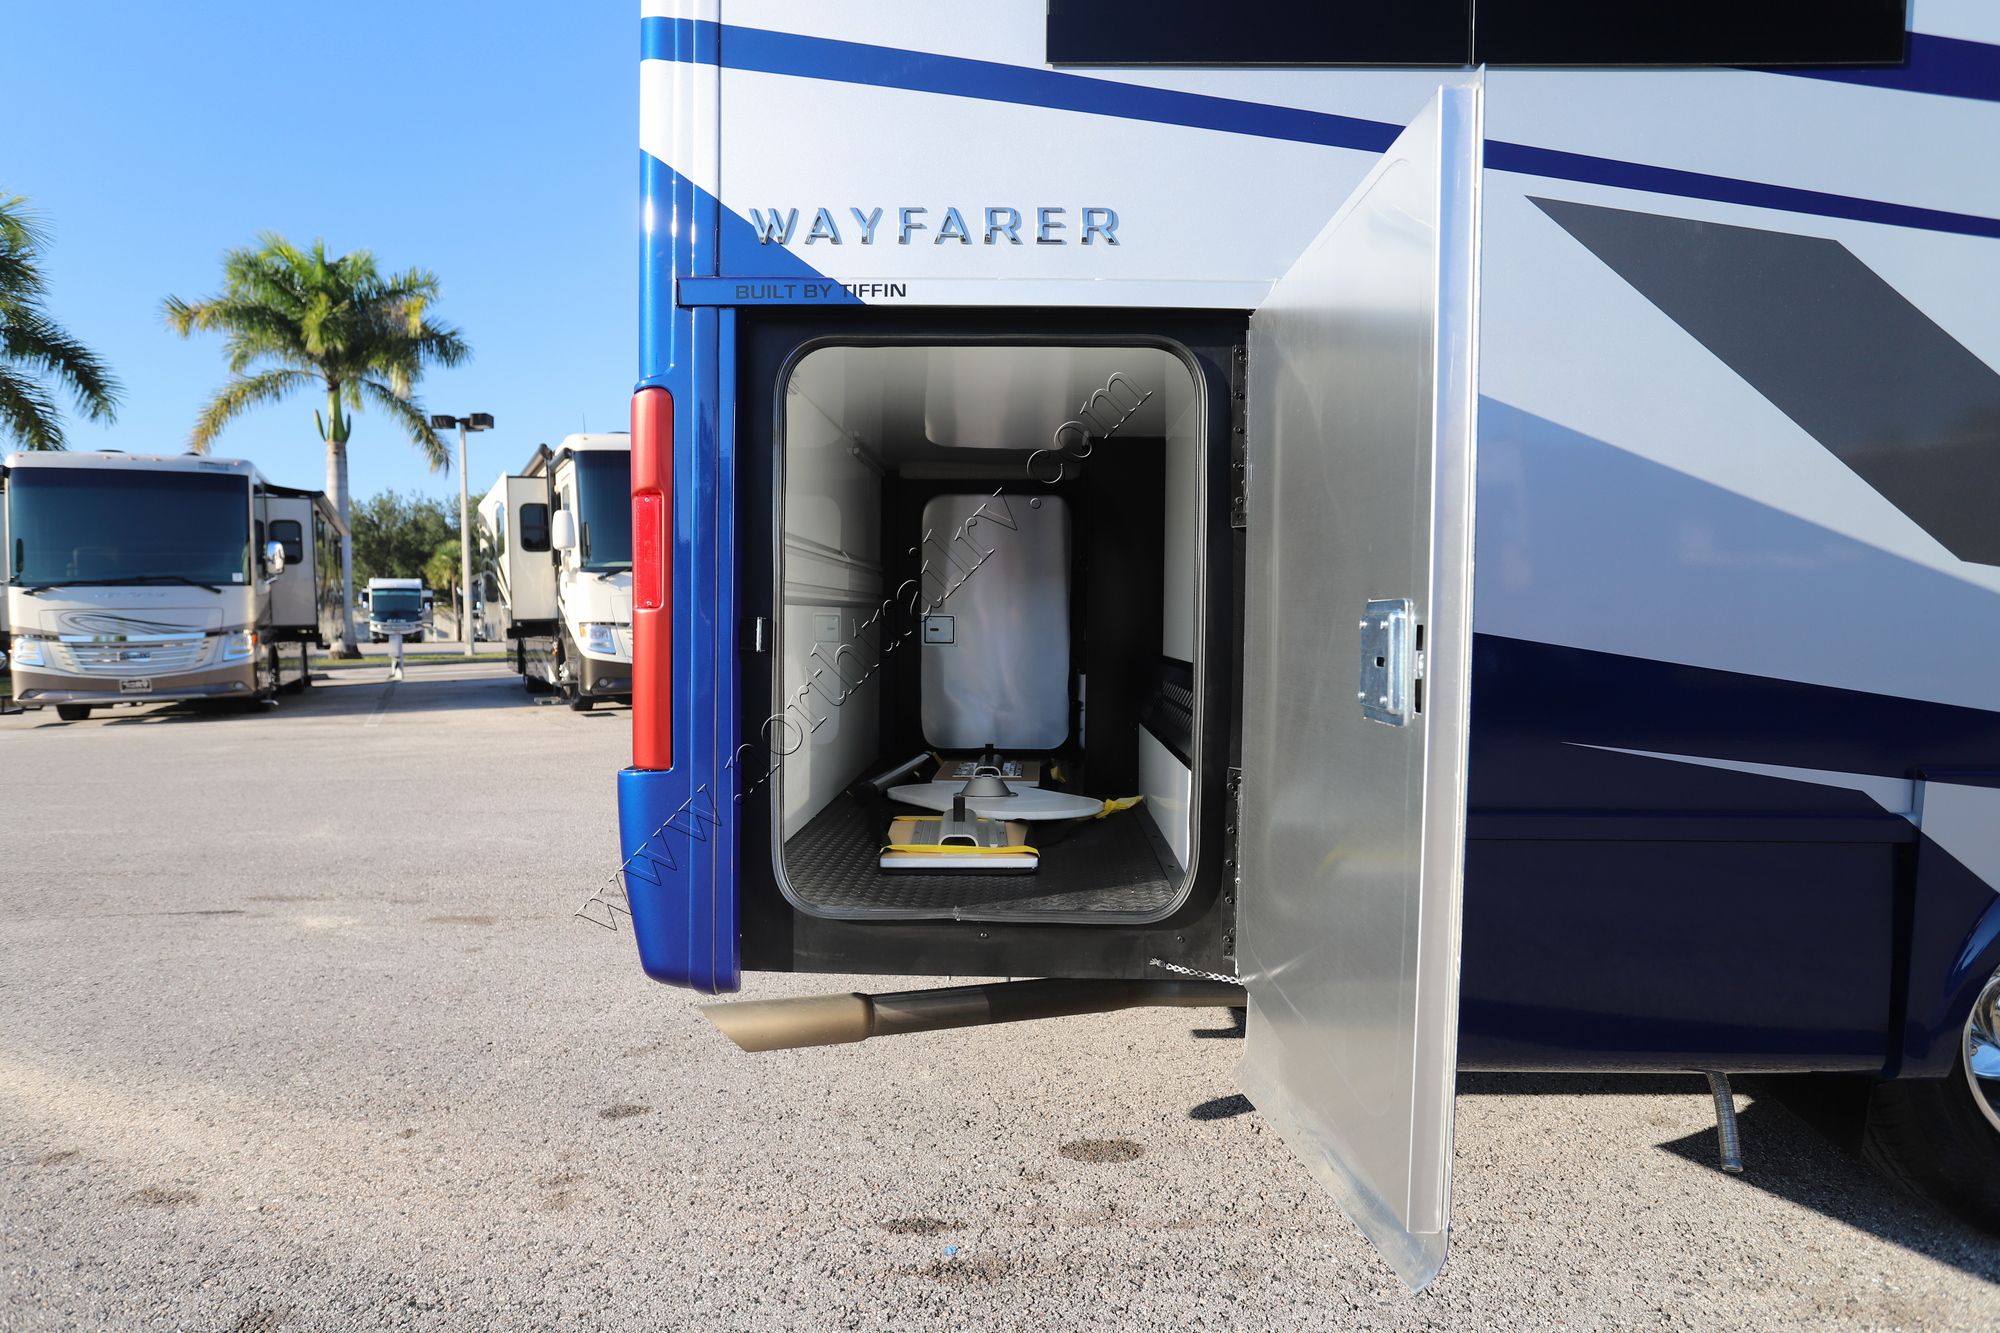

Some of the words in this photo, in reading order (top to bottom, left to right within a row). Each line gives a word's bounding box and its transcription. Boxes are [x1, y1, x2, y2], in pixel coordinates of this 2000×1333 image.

[749, 207, 1121, 245] WAYFARER
[735, 284, 797, 300] BUILT
[803, 284, 833, 299] BY
[840, 283, 907, 298] TIFFIN
